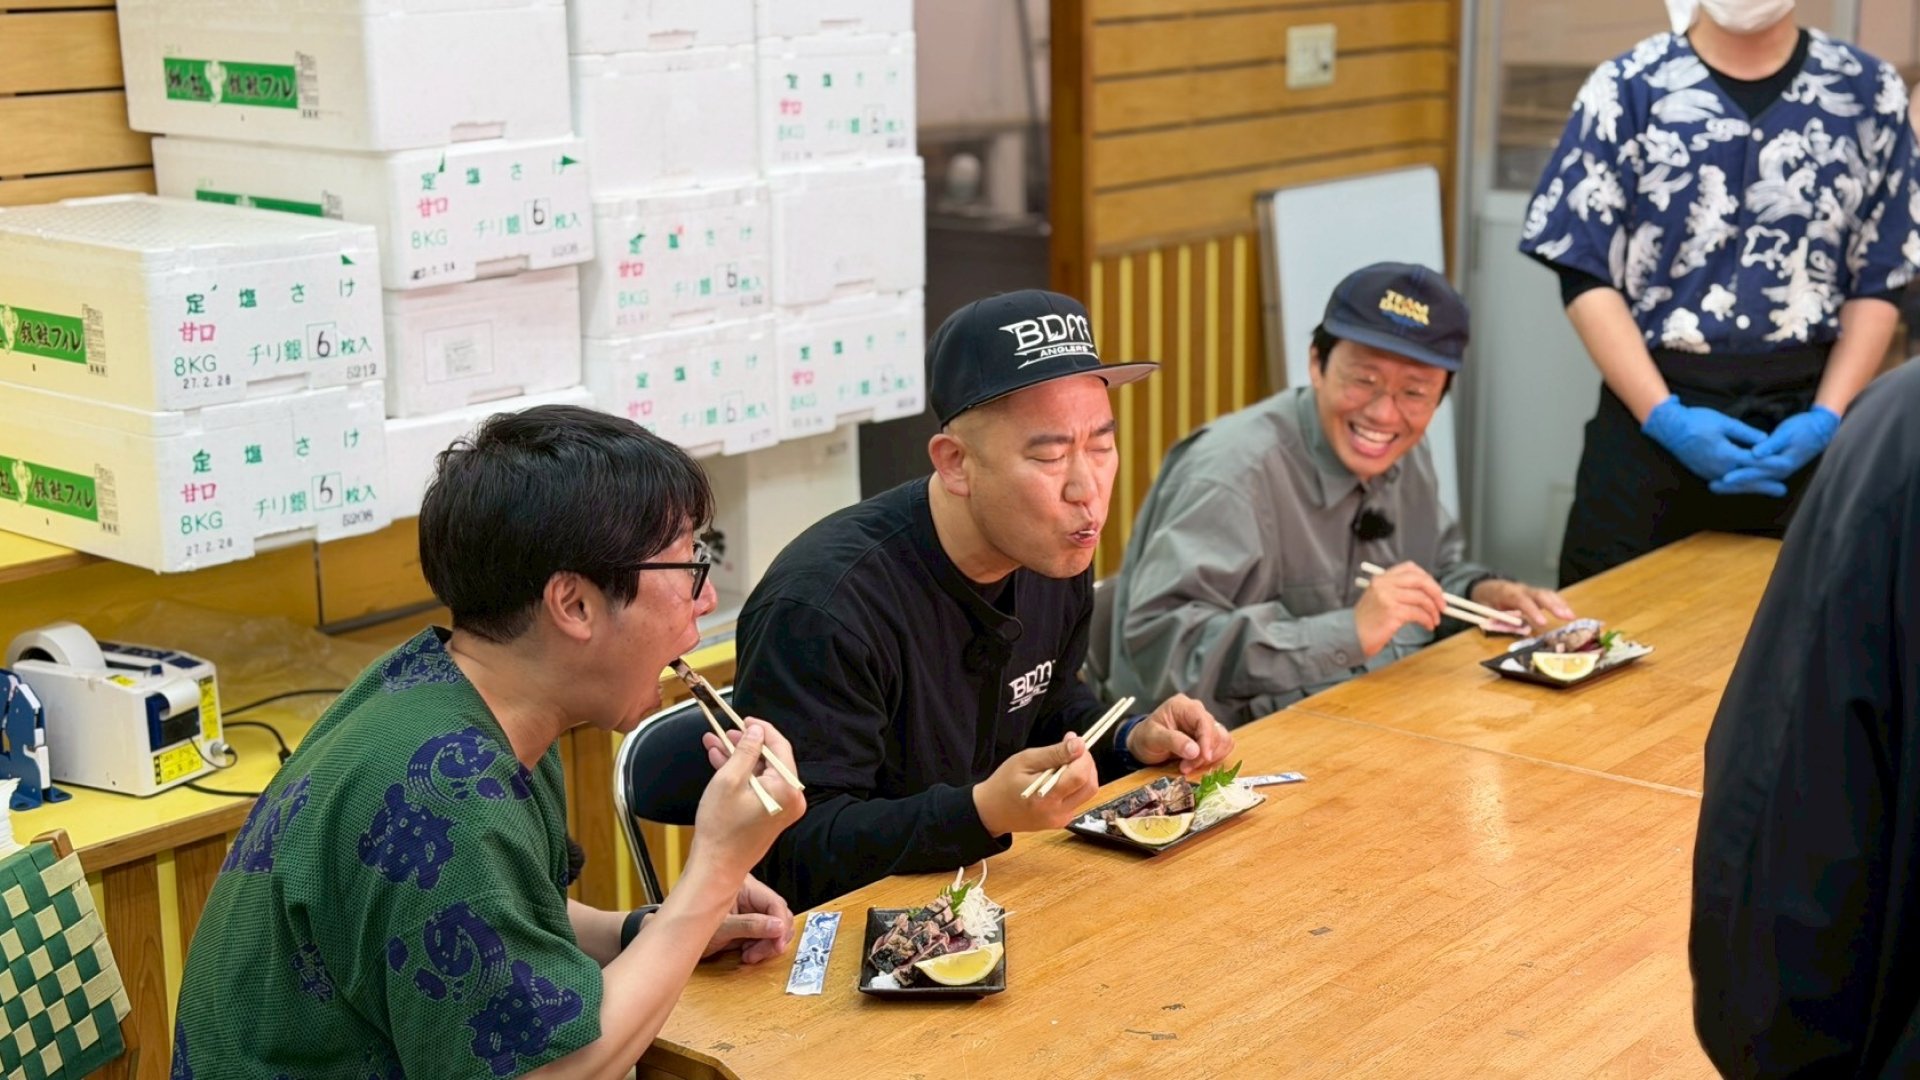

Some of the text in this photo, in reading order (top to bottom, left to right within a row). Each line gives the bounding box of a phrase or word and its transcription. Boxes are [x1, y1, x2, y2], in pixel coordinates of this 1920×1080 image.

[418, 197, 448, 218] 甘口
[533, 199, 545, 225] 6
[411, 229, 448, 249] 8KG
[186, 278, 356, 315] 定塩さけ
[179, 322, 216, 342] 甘口
[999, 313, 1092, 350] BDM
[247, 331, 372, 365] チリ銀 6 枚入
[1040, 345, 1089, 359] ANGLERS
[174, 354, 217, 376] 8KG
[347, 363, 377, 380] 5212
[192, 428, 359, 473] 定塩さけ
[180, 482, 217, 503] 甘口
[254, 491, 306, 518] チリ銀
[346, 484, 376, 503] 枚入
[181, 511, 223, 534] 8KG
[1008, 661, 1053, 700] BDM
